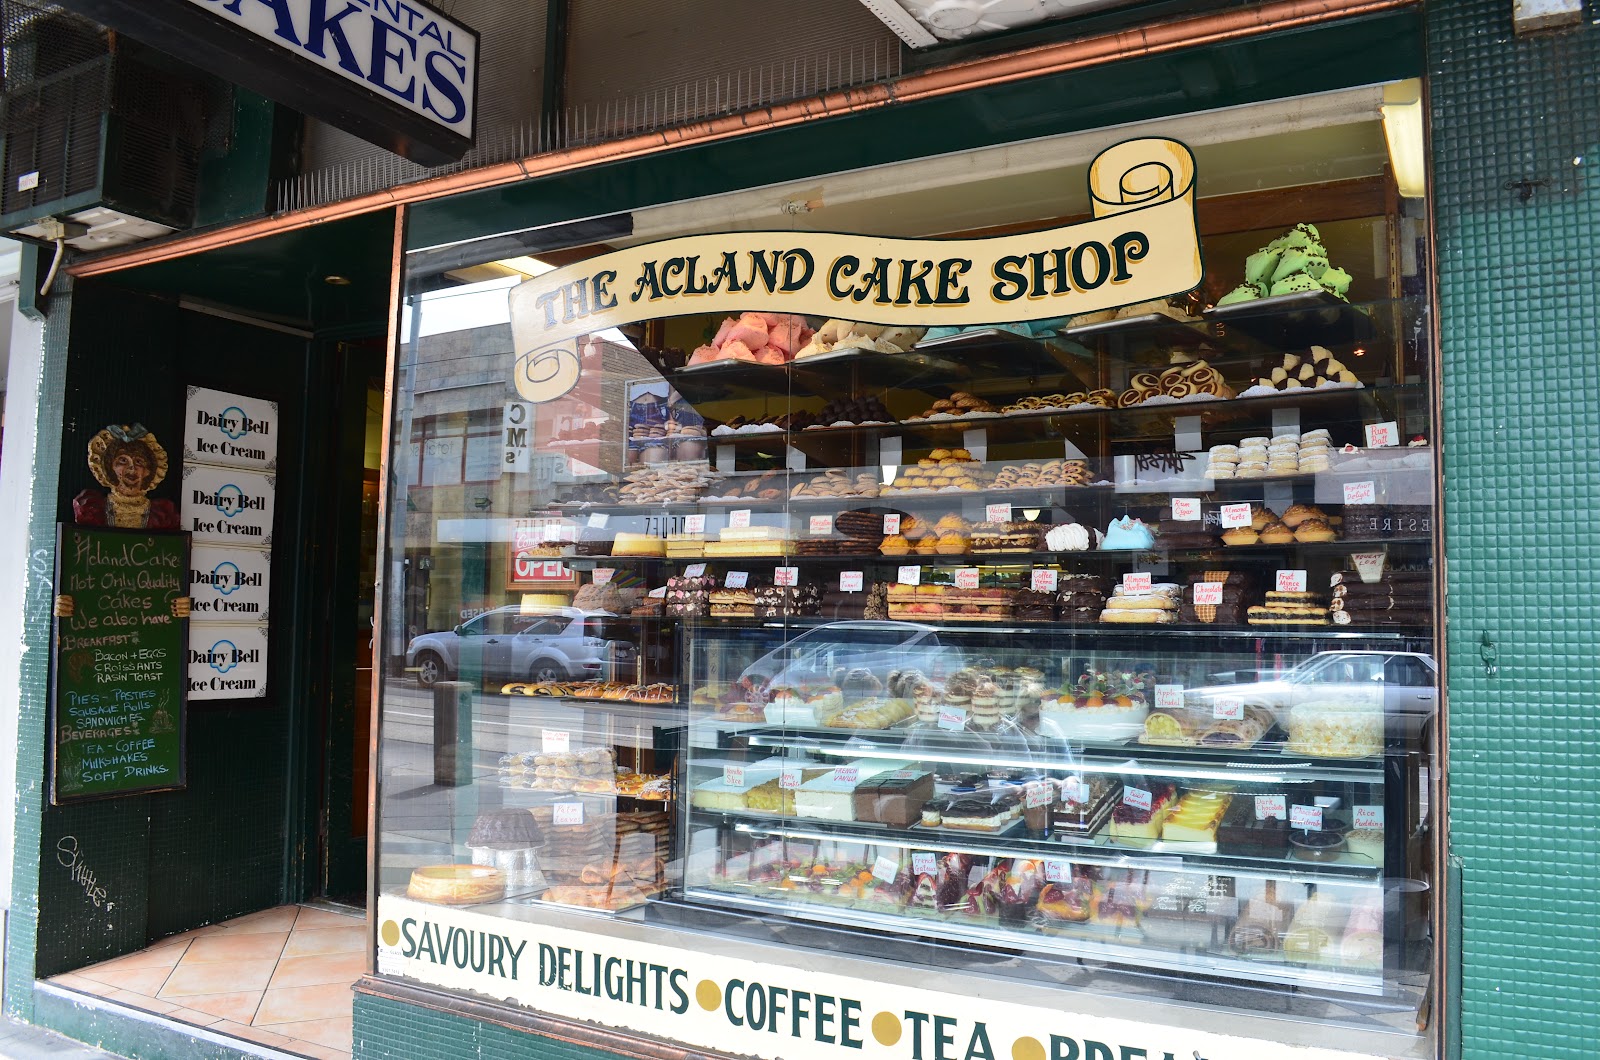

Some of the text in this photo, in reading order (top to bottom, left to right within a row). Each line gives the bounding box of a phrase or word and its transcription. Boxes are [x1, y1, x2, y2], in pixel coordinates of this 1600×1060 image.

[536, 231, 1150, 331] THE ACLAND CAKE SHOP
[197, 410, 269, 435] Dairy Bell
[1371, 425, 1389, 436] Rum
[197, 438, 266, 460] Ice Cream
[193, 490, 265, 510] Dairy Bell
[1174, 499, 1191, 508] Rum
[1223, 504, 1250, 514] Almond
[193, 518, 262, 536] Ice Cream
[515, 551, 571, 577] OPEN
[100, 572, 136, 592] Only
[137, 570, 181, 592] Quality
[190, 570, 262, 588] Dairy Bell
[956, 570, 980, 579] Almond
[1032, 570, 1054, 581] Coffee
[1124, 574, 1151, 584] Almond
[98, 593, 153, 611] Cakes
[213, 598, 259, 613] Cream
[70, 608, 173, 630] We also have
[138, 648, 167, 659] EGGS
[189, 650, 259, 667] Dairy Bell
[129, 672, 164, 682] TOAST
[210, 677, 256, 691] Cream
[65, 690, 100, 706] PIES
[111, 688, 157, 702] PASTIES
[60, 725, 132, 745] BEVERAGES
[115, 738, 156, 753] COFFEE
[82, 770, 118, 783] SOFT
[834, 767, 859, 775] FRENCH
[1256, 797, 1273, 806] Dark
[1356, 808, 1376, 817] Rice
[1354, 818, 1384, 829] Pudding
[401, 917, 1001, 1060] SAVOURY DELIGHTS COFFEE TEA
